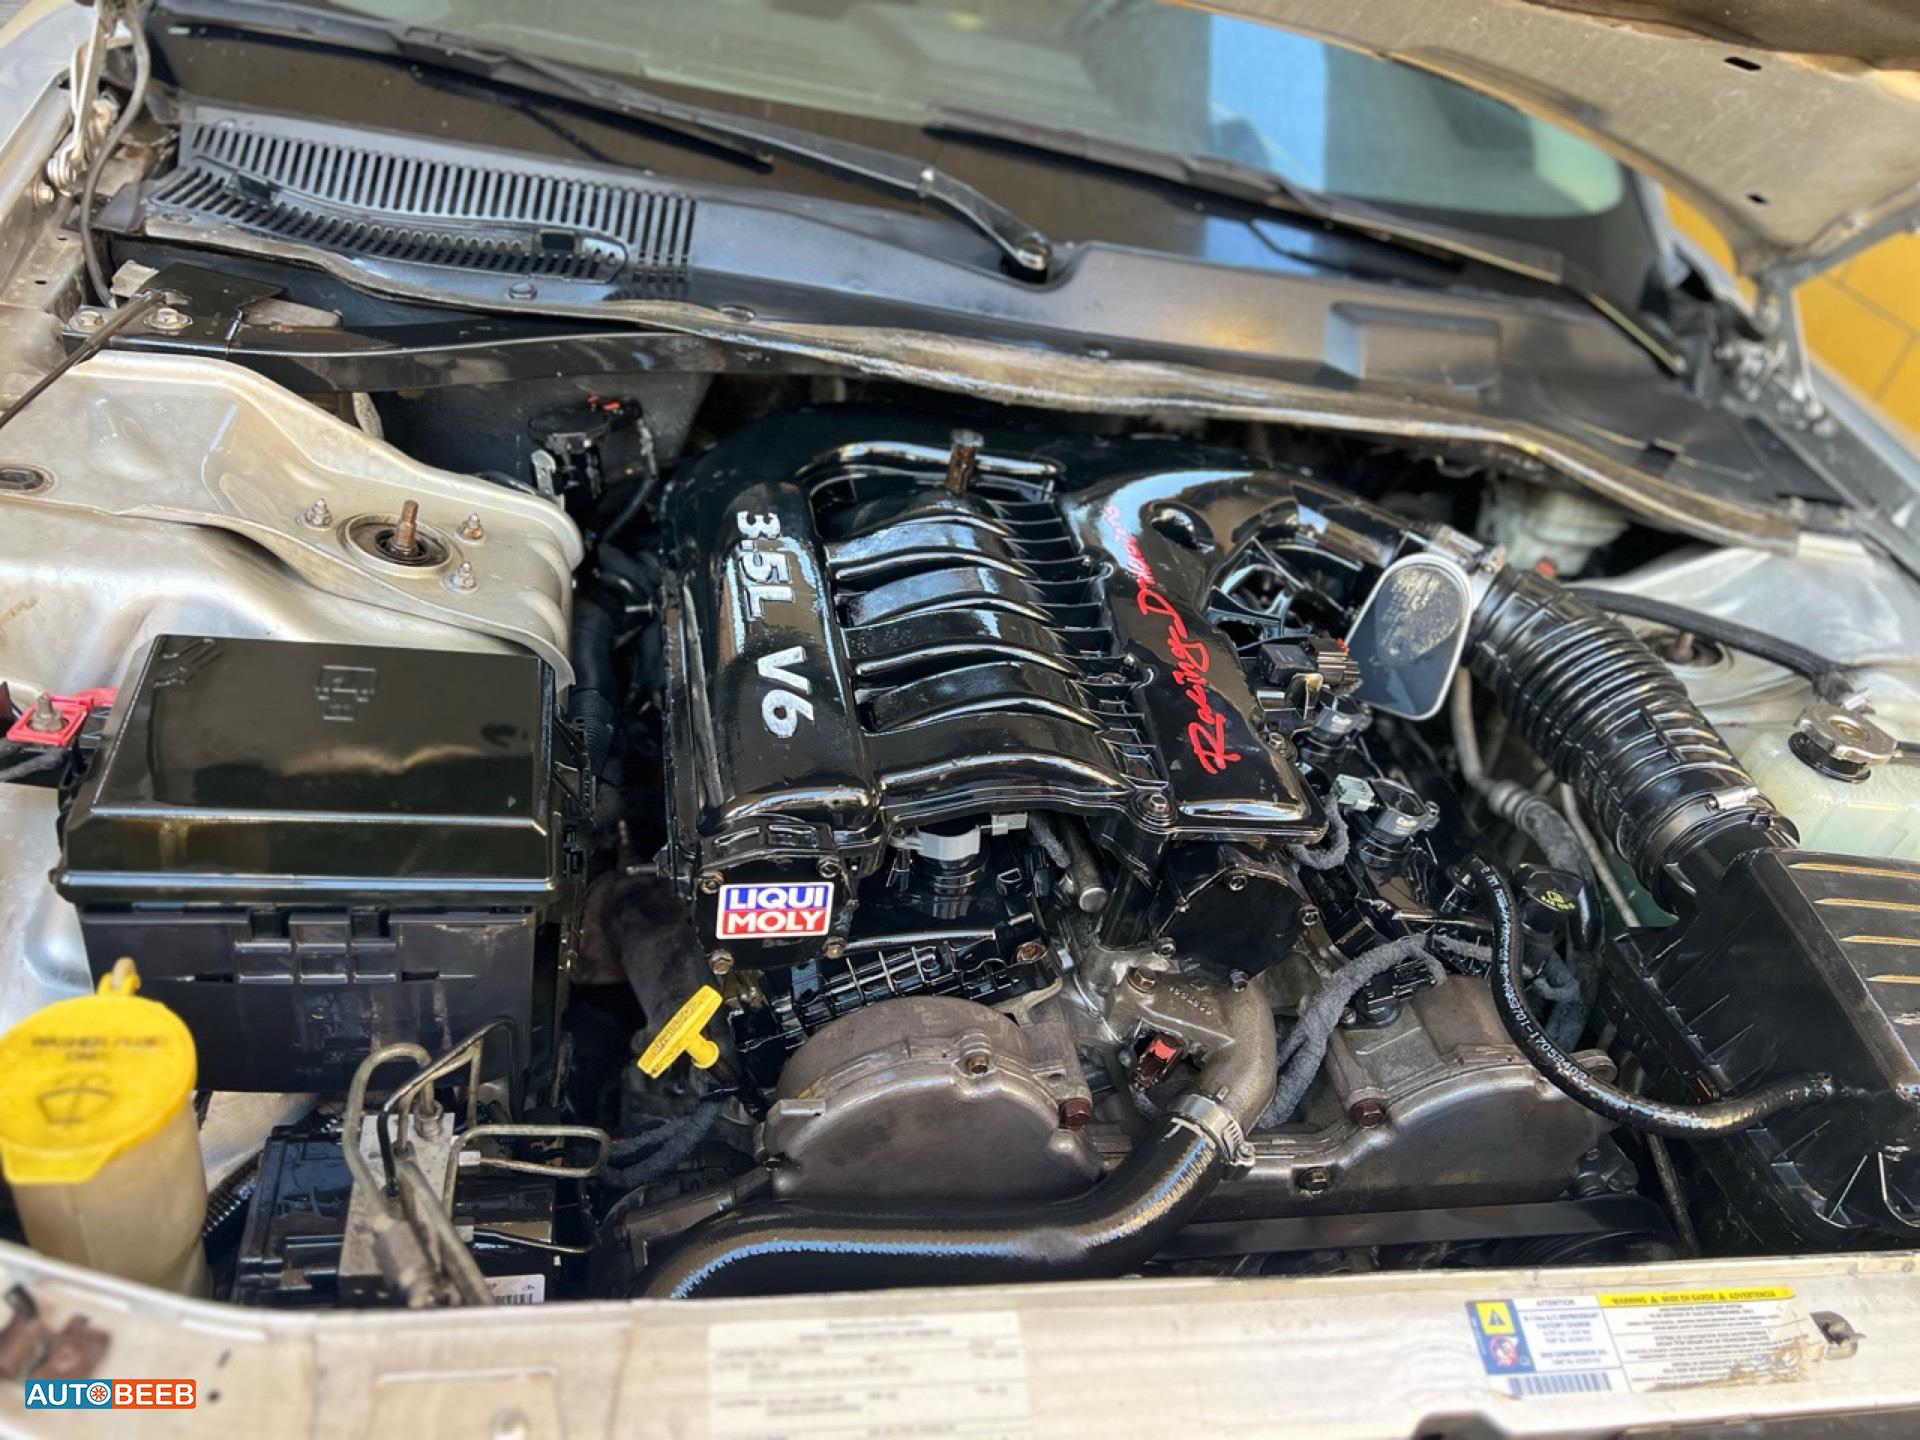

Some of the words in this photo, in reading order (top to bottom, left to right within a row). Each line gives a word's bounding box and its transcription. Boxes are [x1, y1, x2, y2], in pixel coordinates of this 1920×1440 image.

[736, 511, 795, 621] 3.5L
[757, 645, 814, 738] V6
[1166, 623, 1241, 775] Racing
[726, 909, 825, 934] MOLY
[729, 886, 825, 910] LIQUI
